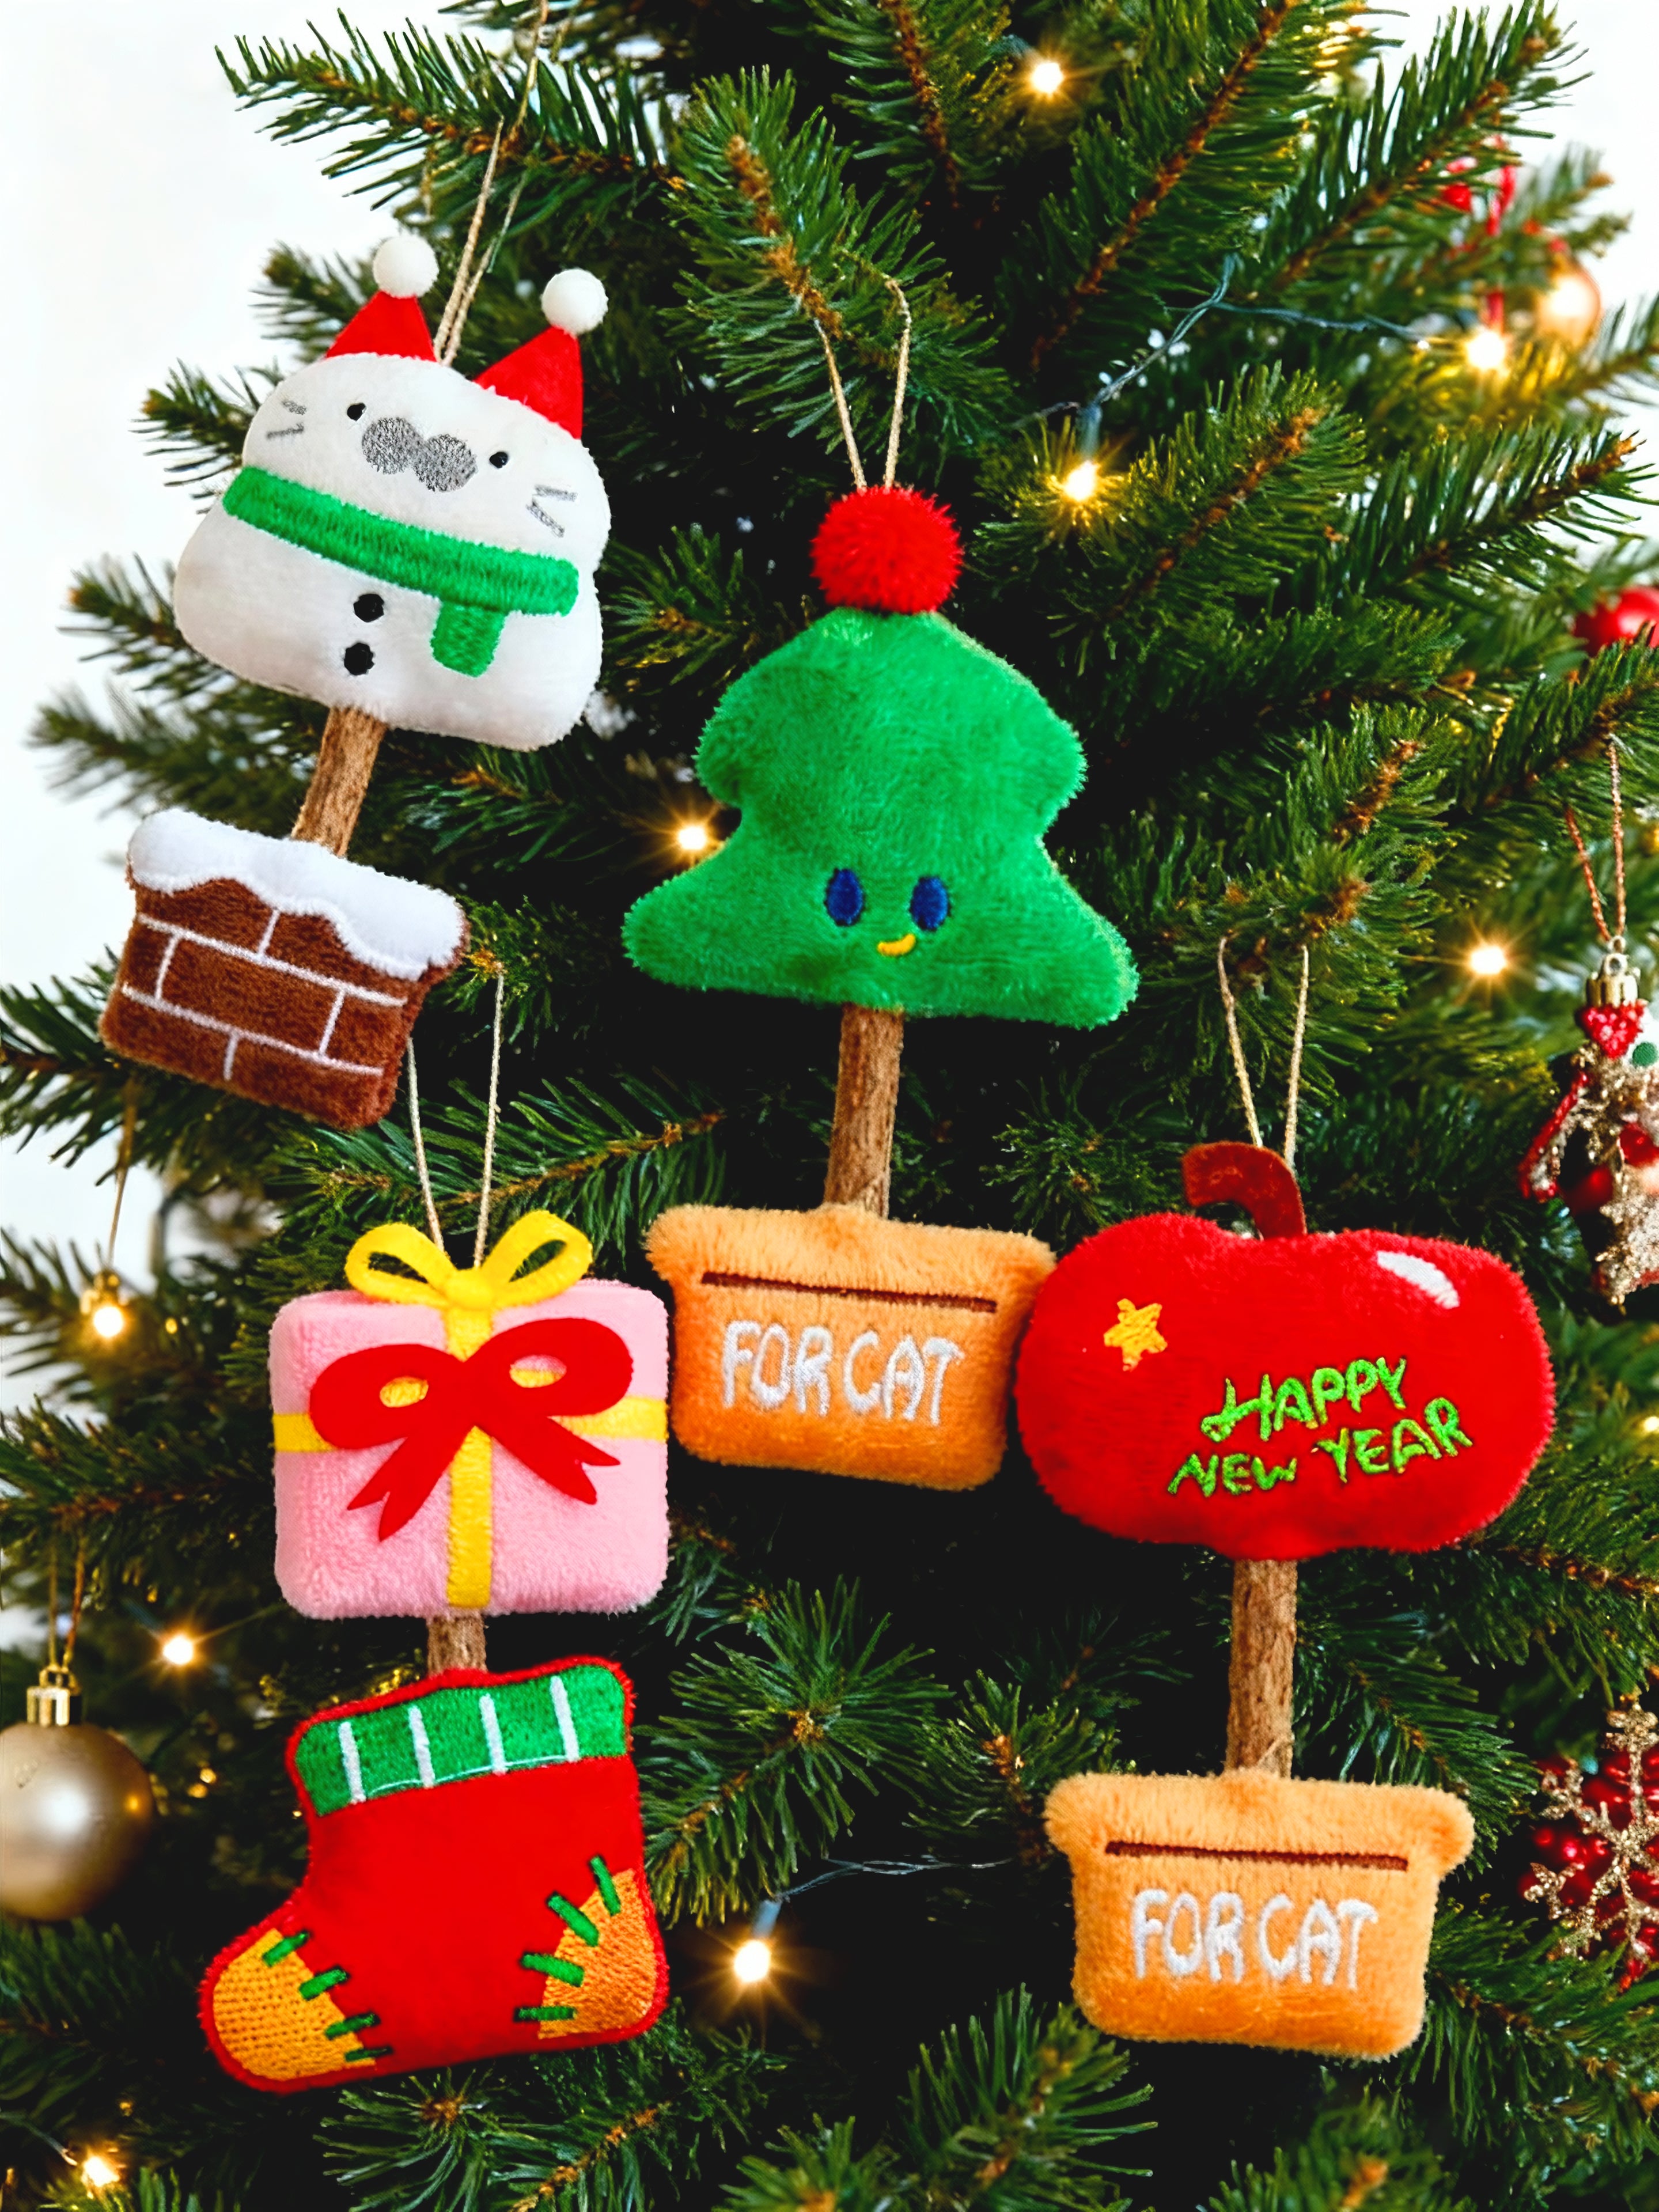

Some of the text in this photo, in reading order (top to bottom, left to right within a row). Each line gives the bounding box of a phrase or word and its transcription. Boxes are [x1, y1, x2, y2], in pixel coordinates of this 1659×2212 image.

[722, 1320, 965, 1426] FOR CAT
[1200, 1356, 1407, 1442] HAPPY
[1167, 1397, 1474, 1498] NEW YEAR
[1132, 1889, 1378, 1991] FOR CAT
